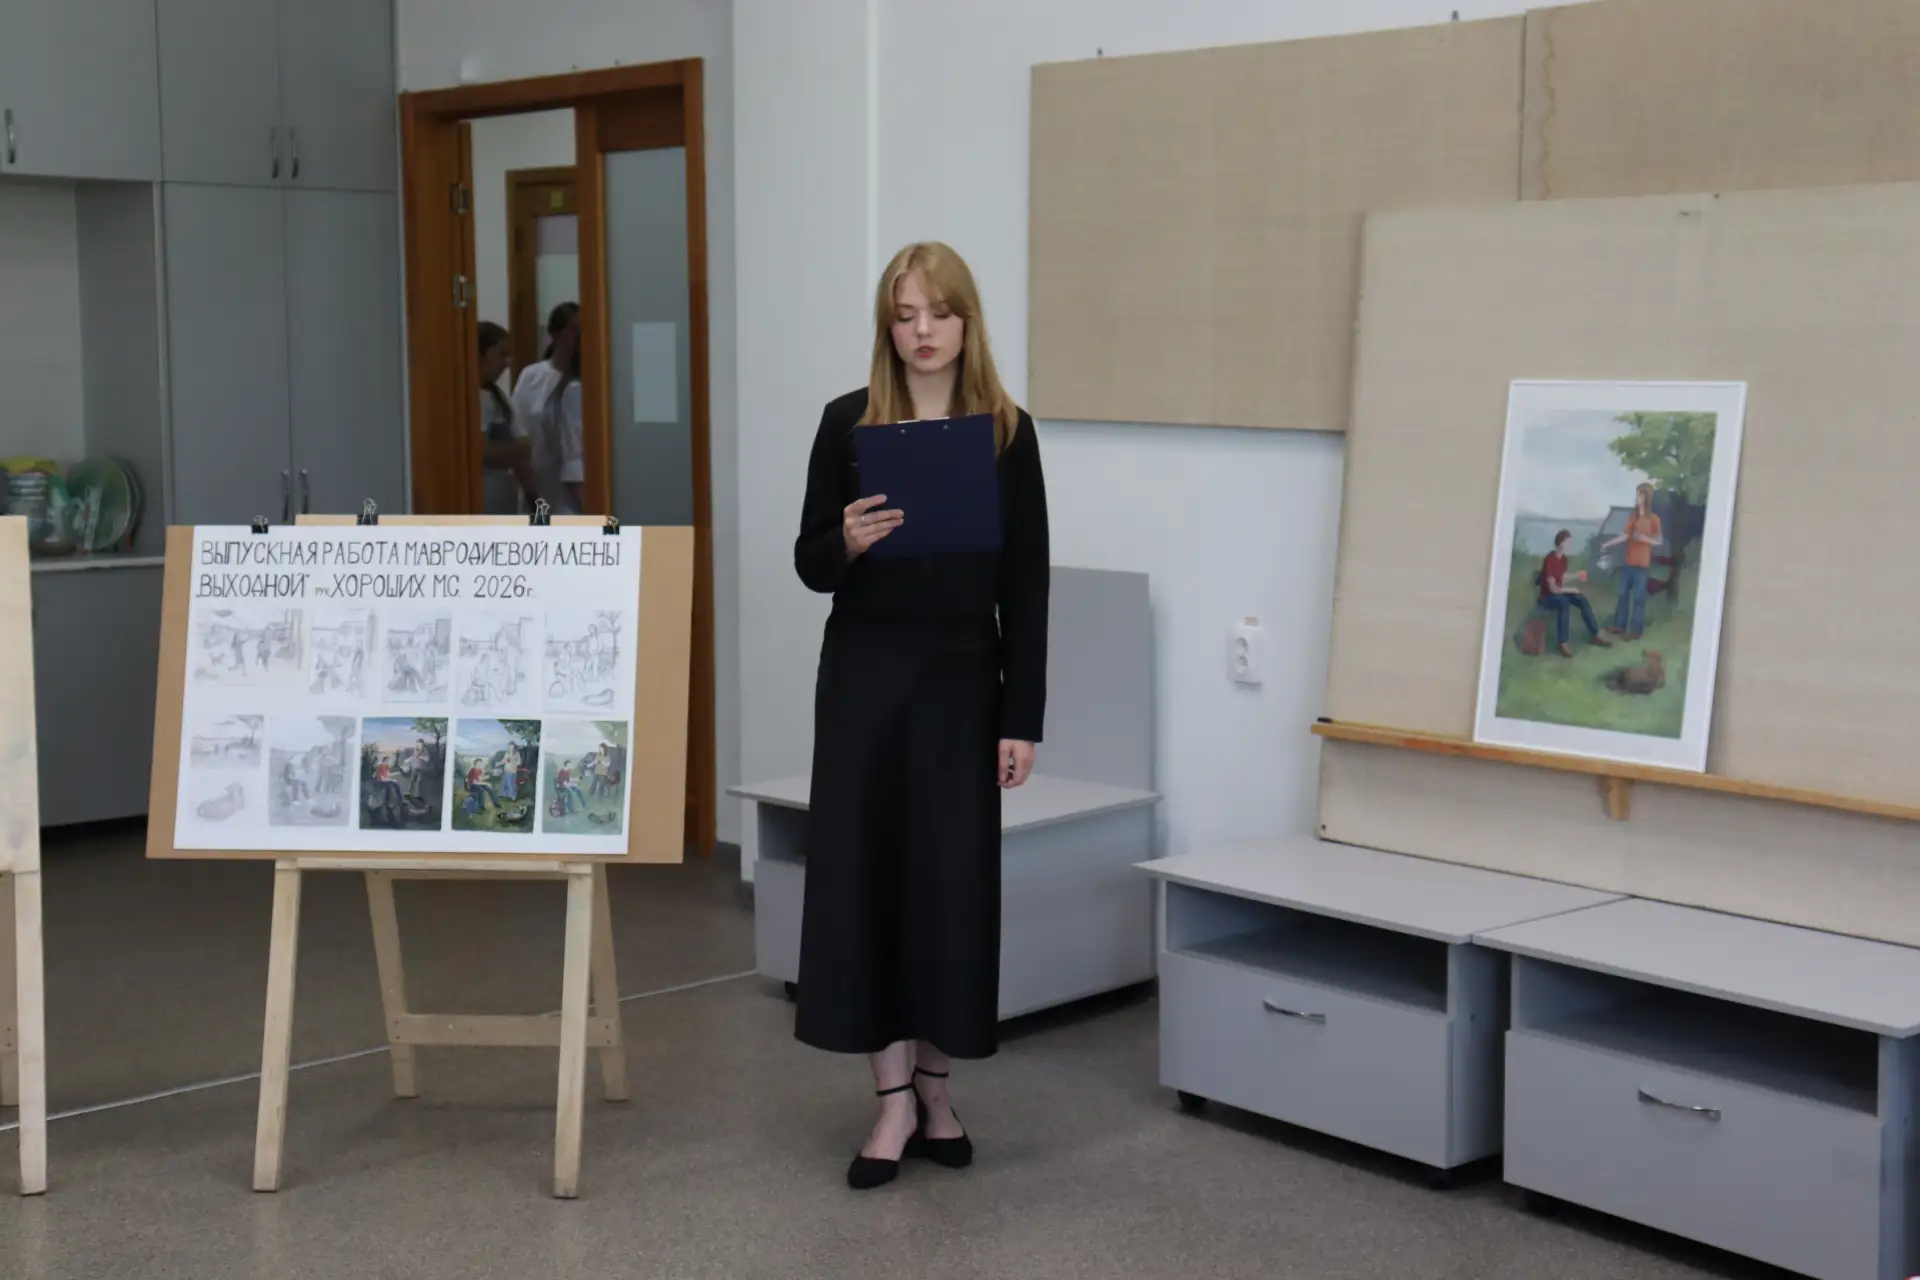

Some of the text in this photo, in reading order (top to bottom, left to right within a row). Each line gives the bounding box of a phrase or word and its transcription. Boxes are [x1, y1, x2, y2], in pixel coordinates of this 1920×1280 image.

[201, 539, 621, 566] ВЫПУСКНАЯ РАБОТА МАВРОДИЕВОЙ АЛЕНЫ
[331, 573, 426, 598] ХОРОШИХ
